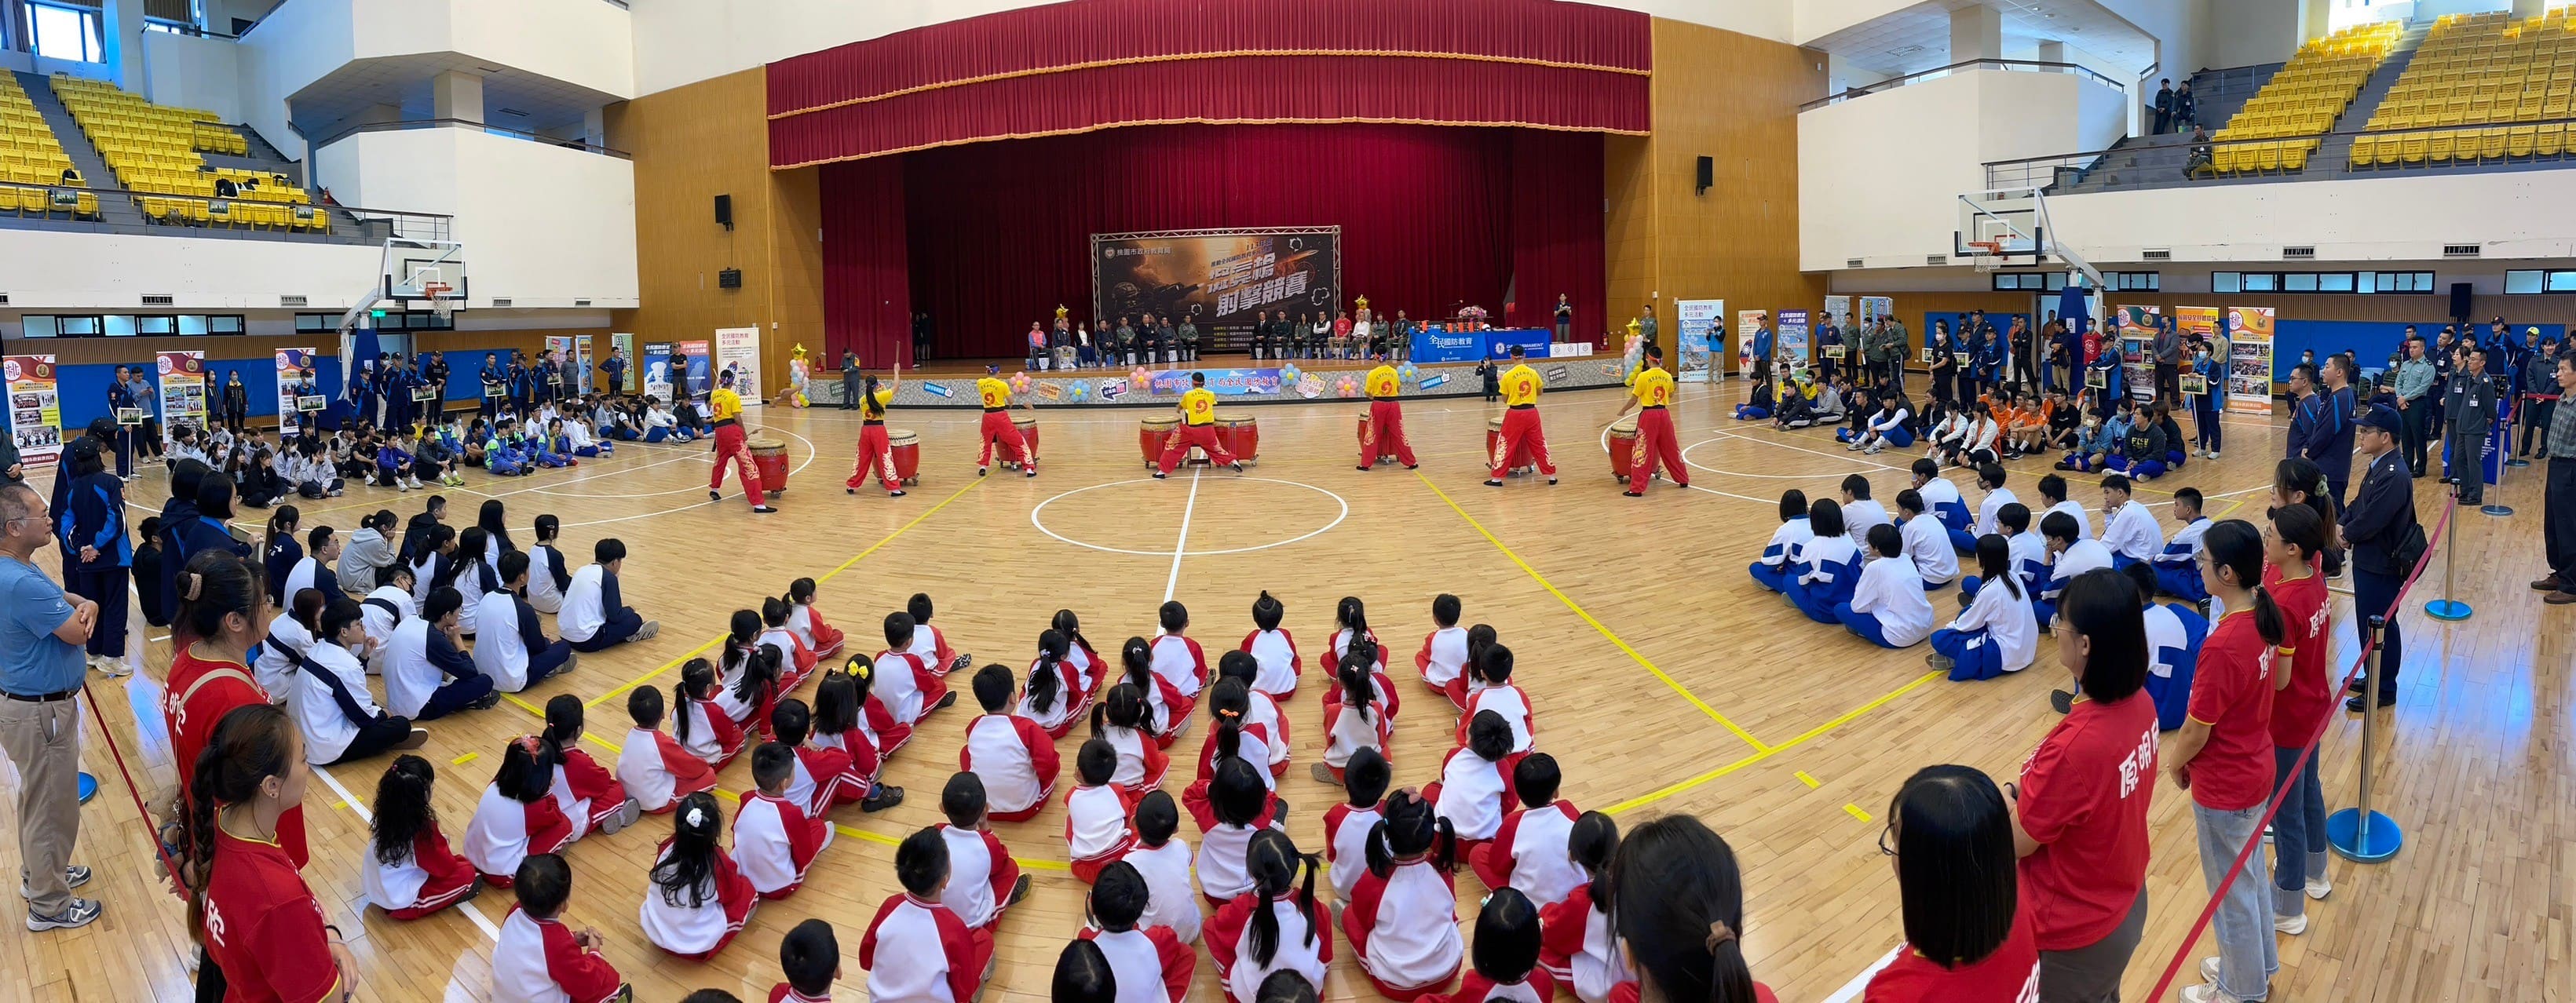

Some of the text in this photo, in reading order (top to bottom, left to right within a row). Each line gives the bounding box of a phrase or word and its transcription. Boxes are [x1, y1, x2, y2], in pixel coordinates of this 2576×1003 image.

[1116, 246, 1171, 256] 桃園市政府教育局
[1215, 270, 1308, 318] 射擊競賽
[1428, 334, 1473, 349] 全民國防教育
[1154, 375, 1279, 389] 桃園市政教育局全民國防教育
[21, 454, 55, 463] 園市政府教育局
